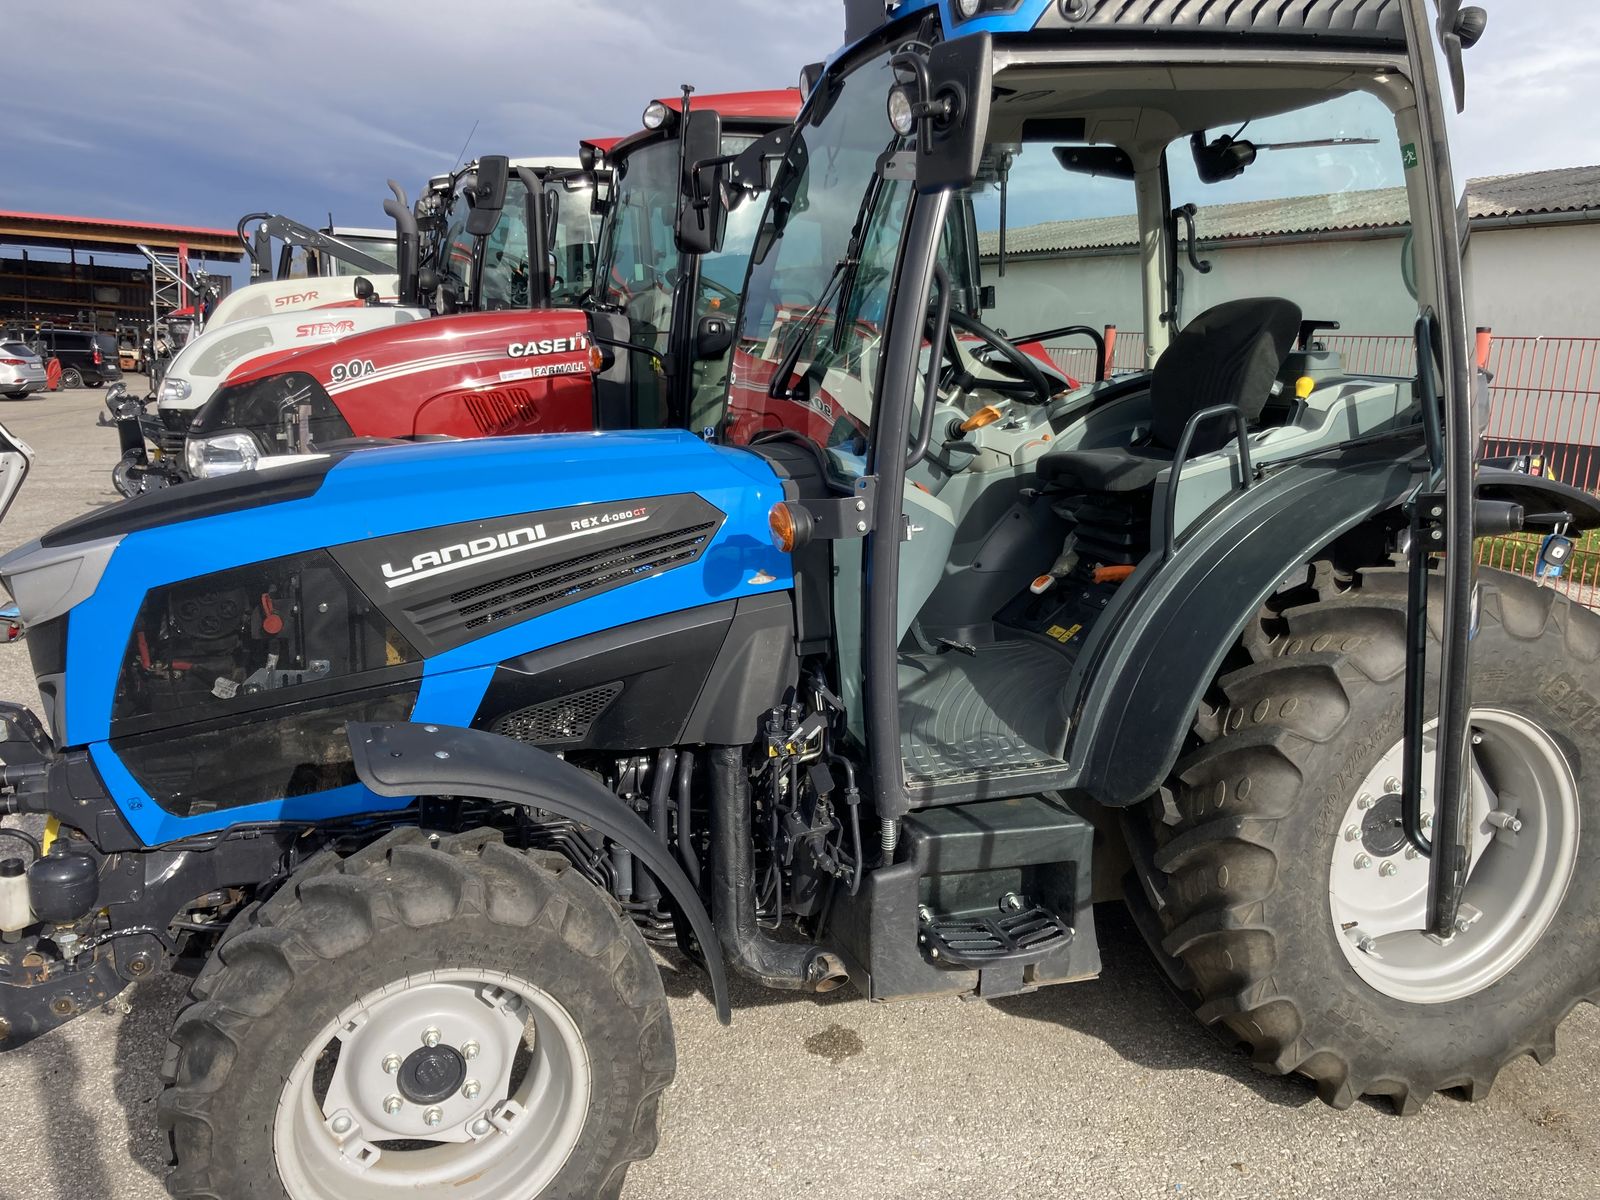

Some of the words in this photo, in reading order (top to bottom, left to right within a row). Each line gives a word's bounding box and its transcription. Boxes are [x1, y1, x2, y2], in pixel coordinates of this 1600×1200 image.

[275, 291, 319, 307] STEYR
[296, 320, 355, 338] STEYR
[507, 338, 567, 358] CASE
[331, 359, 376, 383] 90A
[532, 361, 586, 377] FARMALL
[570, 516, 600, 531] REX
[381, 523, 547, 578] LANDINI
